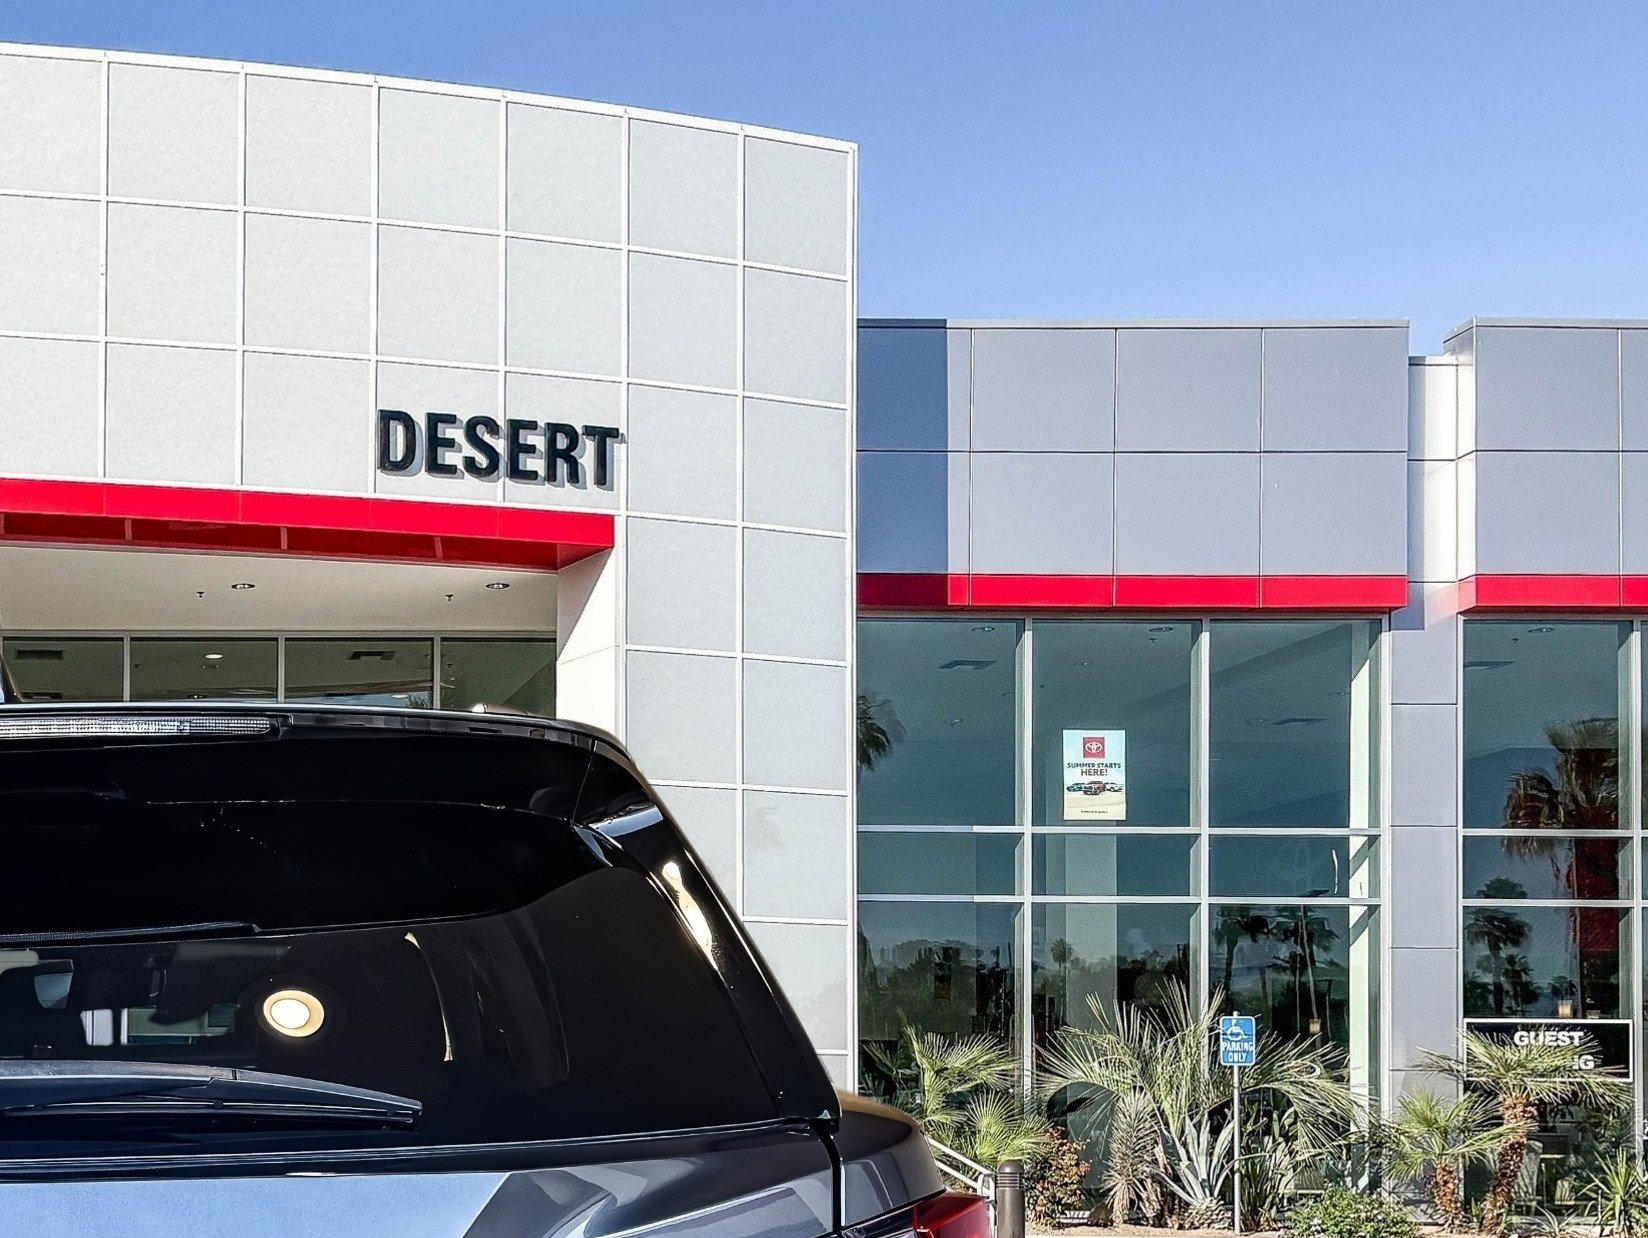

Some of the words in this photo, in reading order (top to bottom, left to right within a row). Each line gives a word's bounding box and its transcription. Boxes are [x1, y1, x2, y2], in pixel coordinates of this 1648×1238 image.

[377, 409, 621, 487] DESERT
[1514, 1031, 1584, 1047] GUEST
[1222, 1042, 1253, 1051] PARKING
[1228, 1052, 1247, 1062] ONLY
